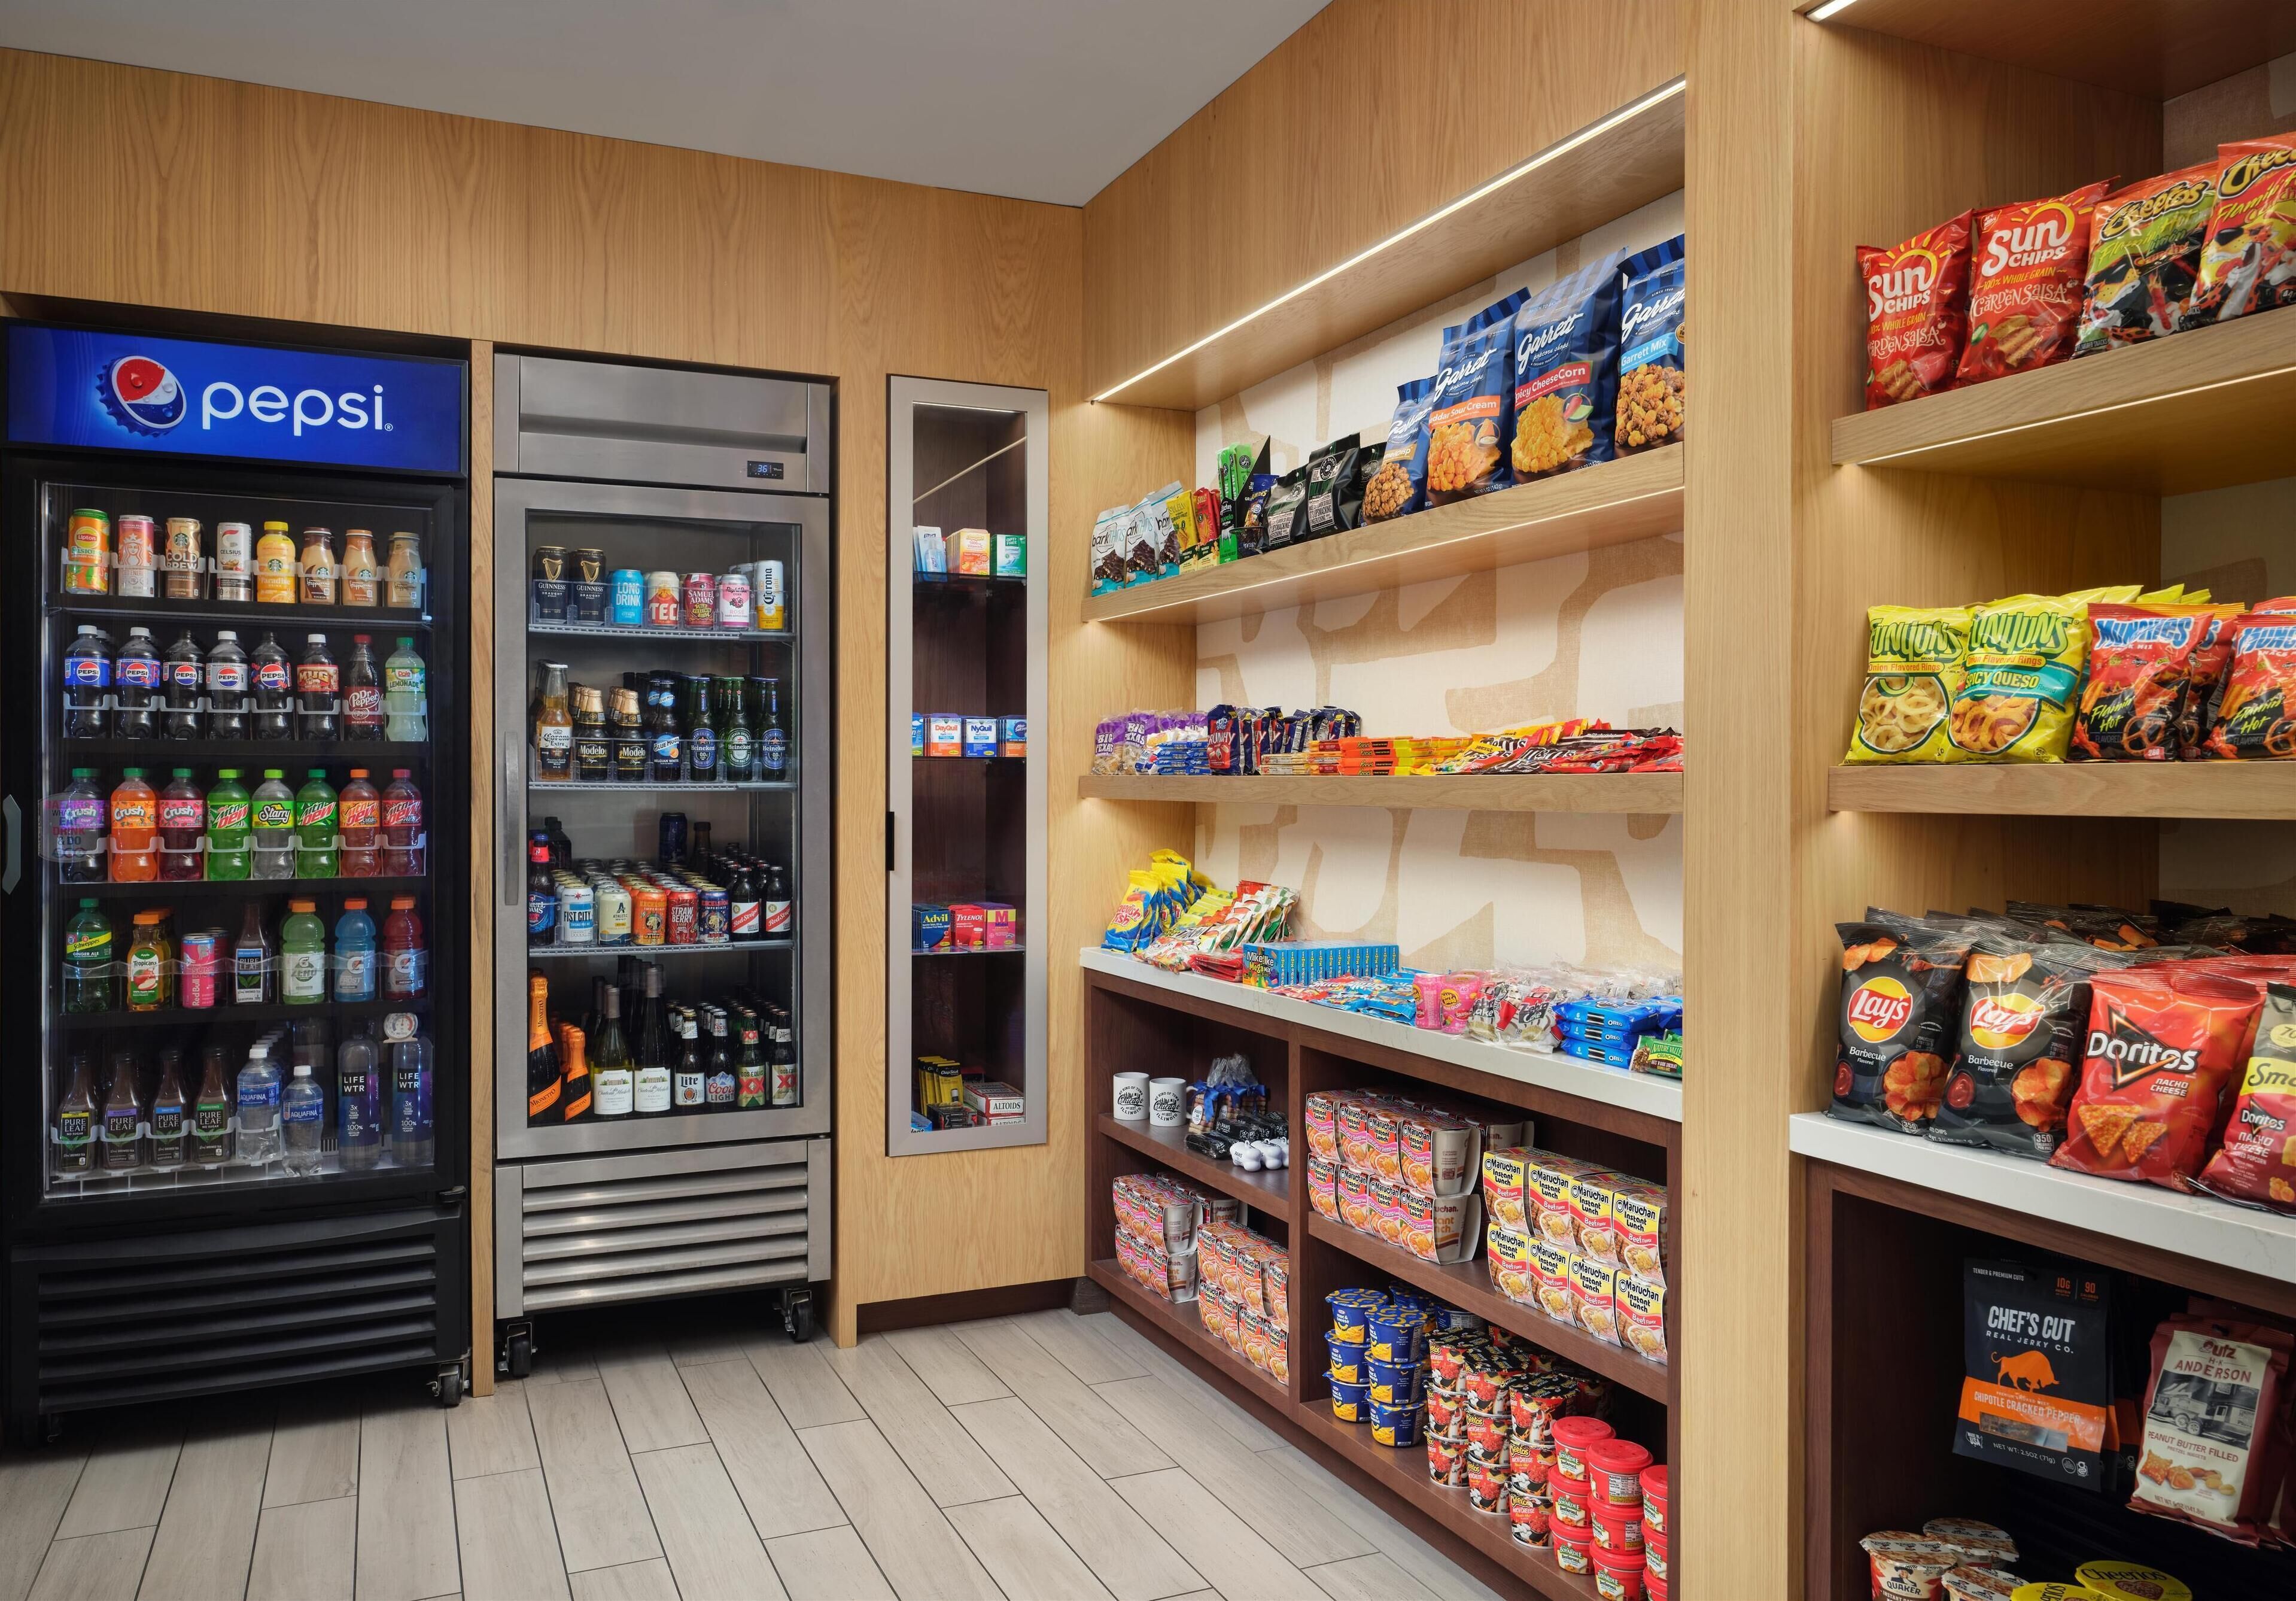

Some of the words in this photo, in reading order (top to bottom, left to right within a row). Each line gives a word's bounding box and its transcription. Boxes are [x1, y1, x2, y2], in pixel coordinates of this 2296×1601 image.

[2100, 181, 2211, 240] Cheetos
[1982, 219, 2060, 277] Sun
[2008, 246, 2067, 268] CHIPS
[1983, 279, 2001, 291] 100%
[2003, 274, 2028, 285] WHOLE
[2030, 266, 2055, 280] GRAIN
[1869, 266, 1932, 322] Sun
[1883, 290, 1931, 314] CHIPS
[1883, 318, 1906, 330] WHOLE
[1907, 312, 1926, 326] GRAIN
[1518, 312, 1585, 375] Garrett
[1533, 347, 1553, 360] popcorn
[1554, 341, 1570, 353] shops
[1621, 345, 1649, 366] Garrett
[1650, 339, 1667, 354] Mix
[202, 382, 384, 436] pepsi
[1430, 412, 1450, 424] eddar
[1450, 406, 1466, 416] Sour
[1467, 400, 1497, 411] Cream
[168, 552, 196, 562] COLD
[618, 582, 640, 594] LONG
[764, 568, 776, 604] Corona
[616, 595, 641, 606] DRINK
[2094, 618, 2195, 650] MUNCHIES
[1984, 655, 2016, 664] Flavored
[2018, 655, 2042, 666] Rings
[1921, 663, 1940, 673] Rings
[299, 670, 329, 683] MUG
[1965, 671, 1991, 688] SPICY
[1993, 672, 2039, 688] QUESO
[352, 694, 378, 706] Pepper
[1127, 722, 1145, 734] BIG
[543, 733, 570, 742] Corona
[1098, 733, 1113, 743] BIG
[580, 745, 604, 755] Modelo
[622, 748, 646, 757] Modelo
[653, 742, 667, 751] BLUE
[114, 806, 145, 821] Crush
[163, 806, 193, 821] Crush
[259, 806, 291, 824] Starry
[564, 912, 577, 922] FIST
[578, 912, 591, 922] CITY
[671, 907, 694, 915] STRAW
[671, 914, 693, 923] BERRY
[733, 918, 743, 927] Red
[743, 909, 758, 921] Stripe
[923, 914, 948, 923] Advil
[73, 937, 100, 950] Schweppes
[1247, 952, 1263, 962] Mike
[1519, 1002, 1549, 1013] Zebra
[1851, 989, 1909, 1029] Lay's
[1523, 1011, 1542, 1022] Cake
[1972, 1001, 2033, 1034] Lay's
[1849, 1046, 1886, 1062] Barbecue
[2087, 1032, 2201, 1074] Doritos
[1968, 1055, 2014, 1070] Barbecue
[680, 1077, 698, 1087] Lite
[2155, 1078, 2189, 1089] NACHO
[2150, 1084, 2187, 1097] CHEESE
[530, 1089, 556, 1107] MIONETTO
[1118, 1095, 1144, 1105] Chicago
[1154, 1101, 1180, 1110] Chicago
[291, 1110, 318, 1118] AQUAFINA
[2241, 1110, 2285, 1131] Doritos
[2036, 1134, 2051, 1143] 350
[2238, 1132, 2274, 1146] NACHO
[2233, 1143, 2269, 1158] CHEESE
[1491, 1158, 1520, 1174] Maruchan
[1492, 1169, 1513, 1180] Instant
[1537, 1169, 1568, 1188] Maruchan
[1495, 1177, 1511, 1186] Lunch
[1540, 1181, 1560, 1193] Instant
[1542, 1189, 1558, 1199] Lunch
[1578, 1184, 1609, 1204] Maruchan
[1624, 1212, 1647, 1225] Instant
[1626, 1220, 1644, 1232] Lunch
[1629, 1233, 1642, 1244] Beef
[1973, 1268, 1988, 1276] TENDER
[1992, 1271, 2012, 1279] PREMIUM
[1543, 1275, 1555, 1286] Beef
[2084, 1281, 2096, 1293] 90
[1987, 1305, 2039, 1336] CHEF'S
[2042, 1315, 2075, 1343] CUT
[1986, 1330, 2011, 1341] REAL
[2017, 1337, 2048, 1349] JERKY
[2055, 1344, 2074, 1354] CO.
[2175, 1359, 2252, 1383] ANDERSON
[1974, 1391, 2005, 1409] CHIPOTLE
[2006, 1399, 2045, 1417] CRACKED
[2046, 1408, 2081, 1424] PEPPER
[2148, 1430, 2176, 1445] PEANUT
[2176, 1438, 2207, 1454] BUTTER
[2209, 1448, 2239, 1463] FILLED
[2081, 1568, 2167, 1581] Cheerios
[1886, 1581, 1921, 1595] QUAKER
